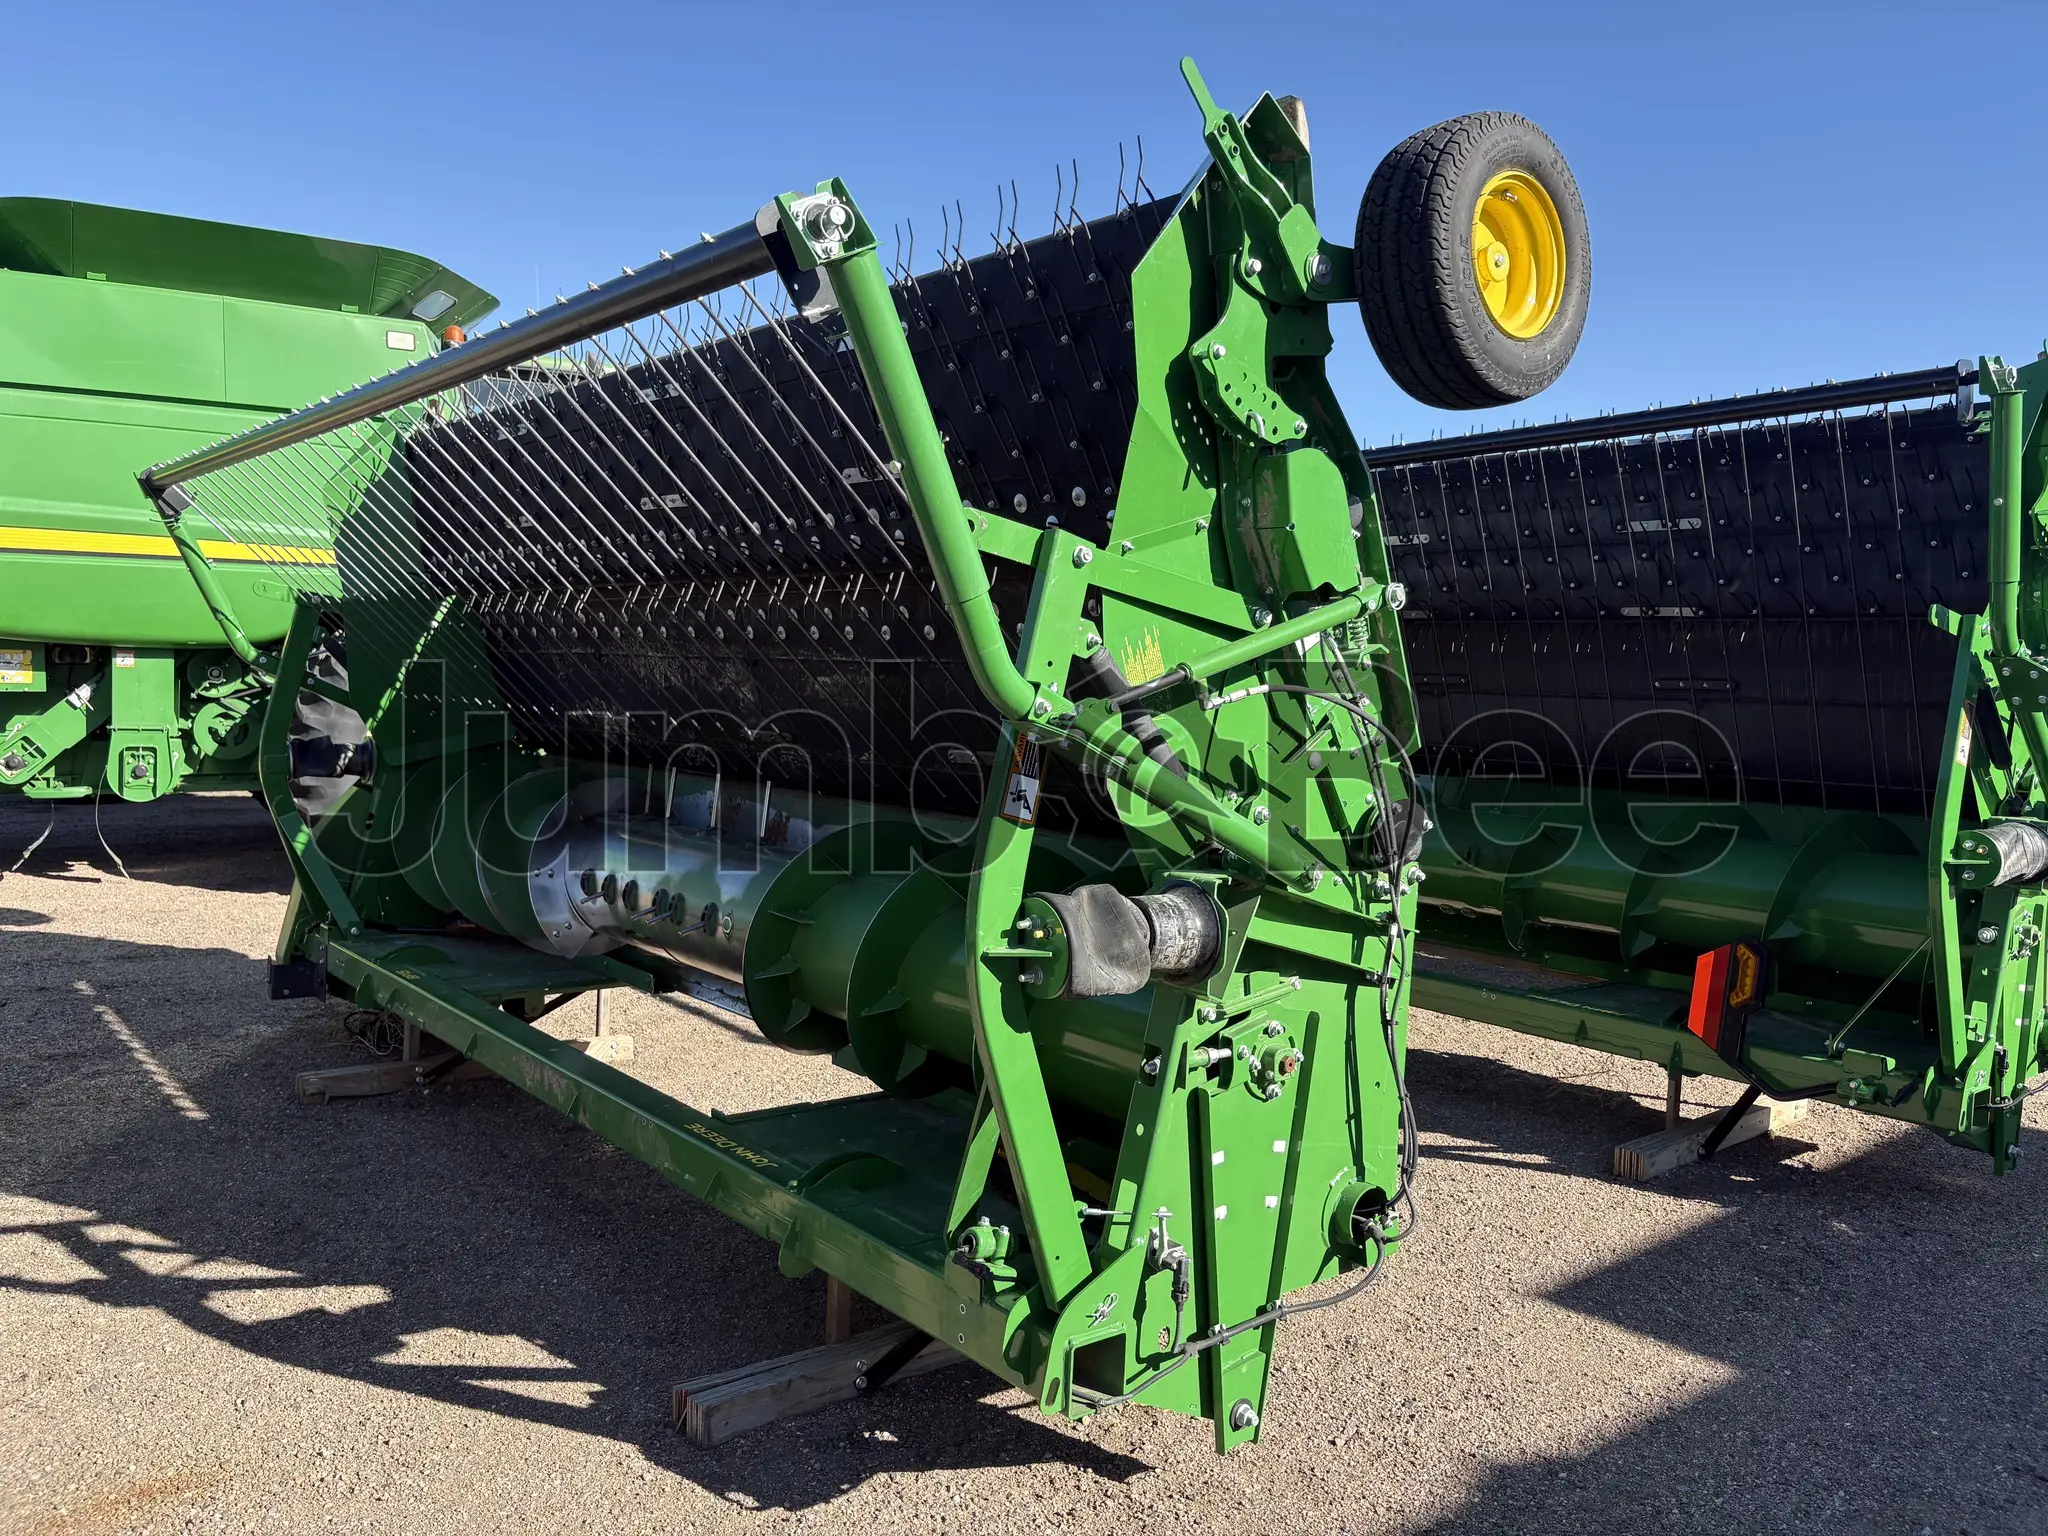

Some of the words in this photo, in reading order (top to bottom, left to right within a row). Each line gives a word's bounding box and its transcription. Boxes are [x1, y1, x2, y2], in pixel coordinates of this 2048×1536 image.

[1459, 233, 1496, 343] CARLISLE
[683, 1122, 737, 1148] DEERE
[728, 1146, 779, 1168] JOHN
